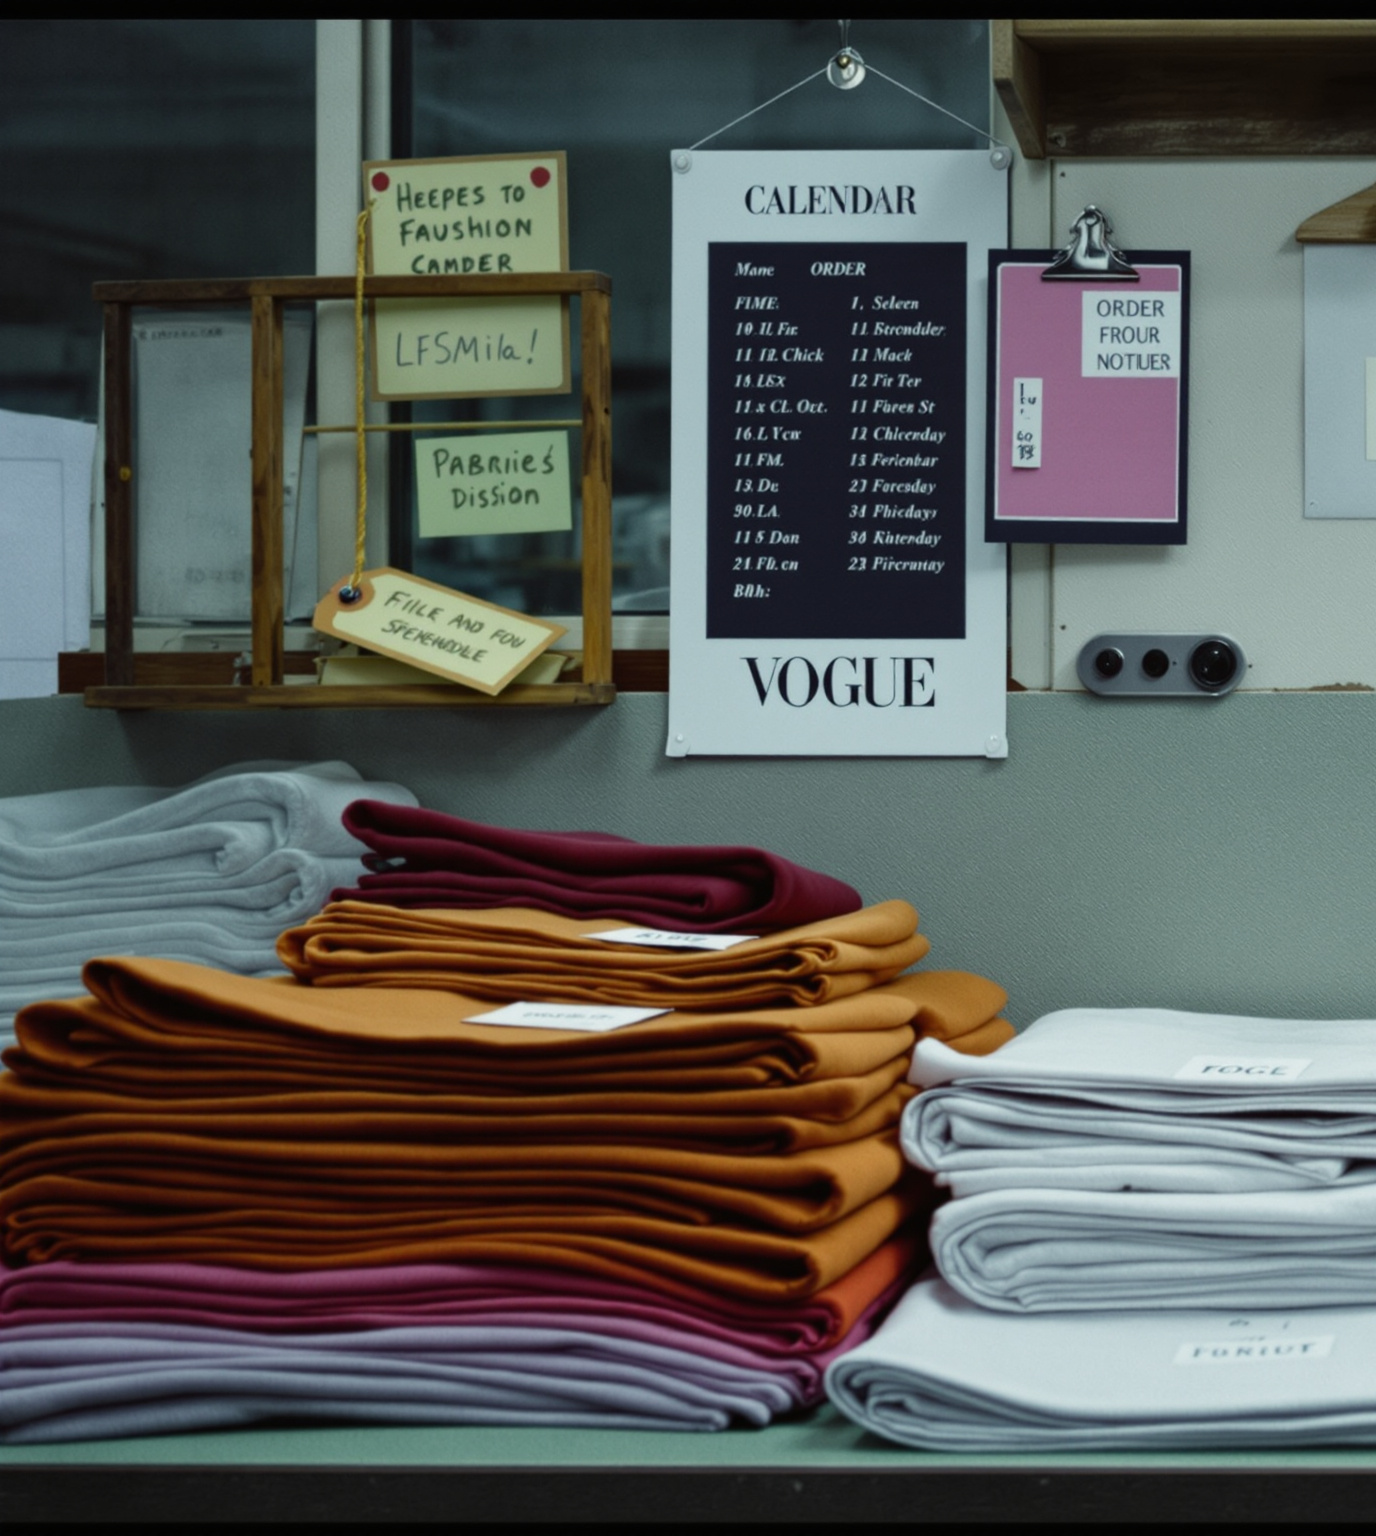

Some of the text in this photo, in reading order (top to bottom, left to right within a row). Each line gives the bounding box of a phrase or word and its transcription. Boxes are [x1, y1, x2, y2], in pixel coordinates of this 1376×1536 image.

[396, 182, 525, 212] HEEPES TO
[745, 185, 917, 215] CALENDAR
[810, 261, 867, 277] ORDER
[1096, 299, 1165, 318] ORDER
[1100, 325, 1160, 344] FROUR
[740, 656, 936, 708] VOGUE
